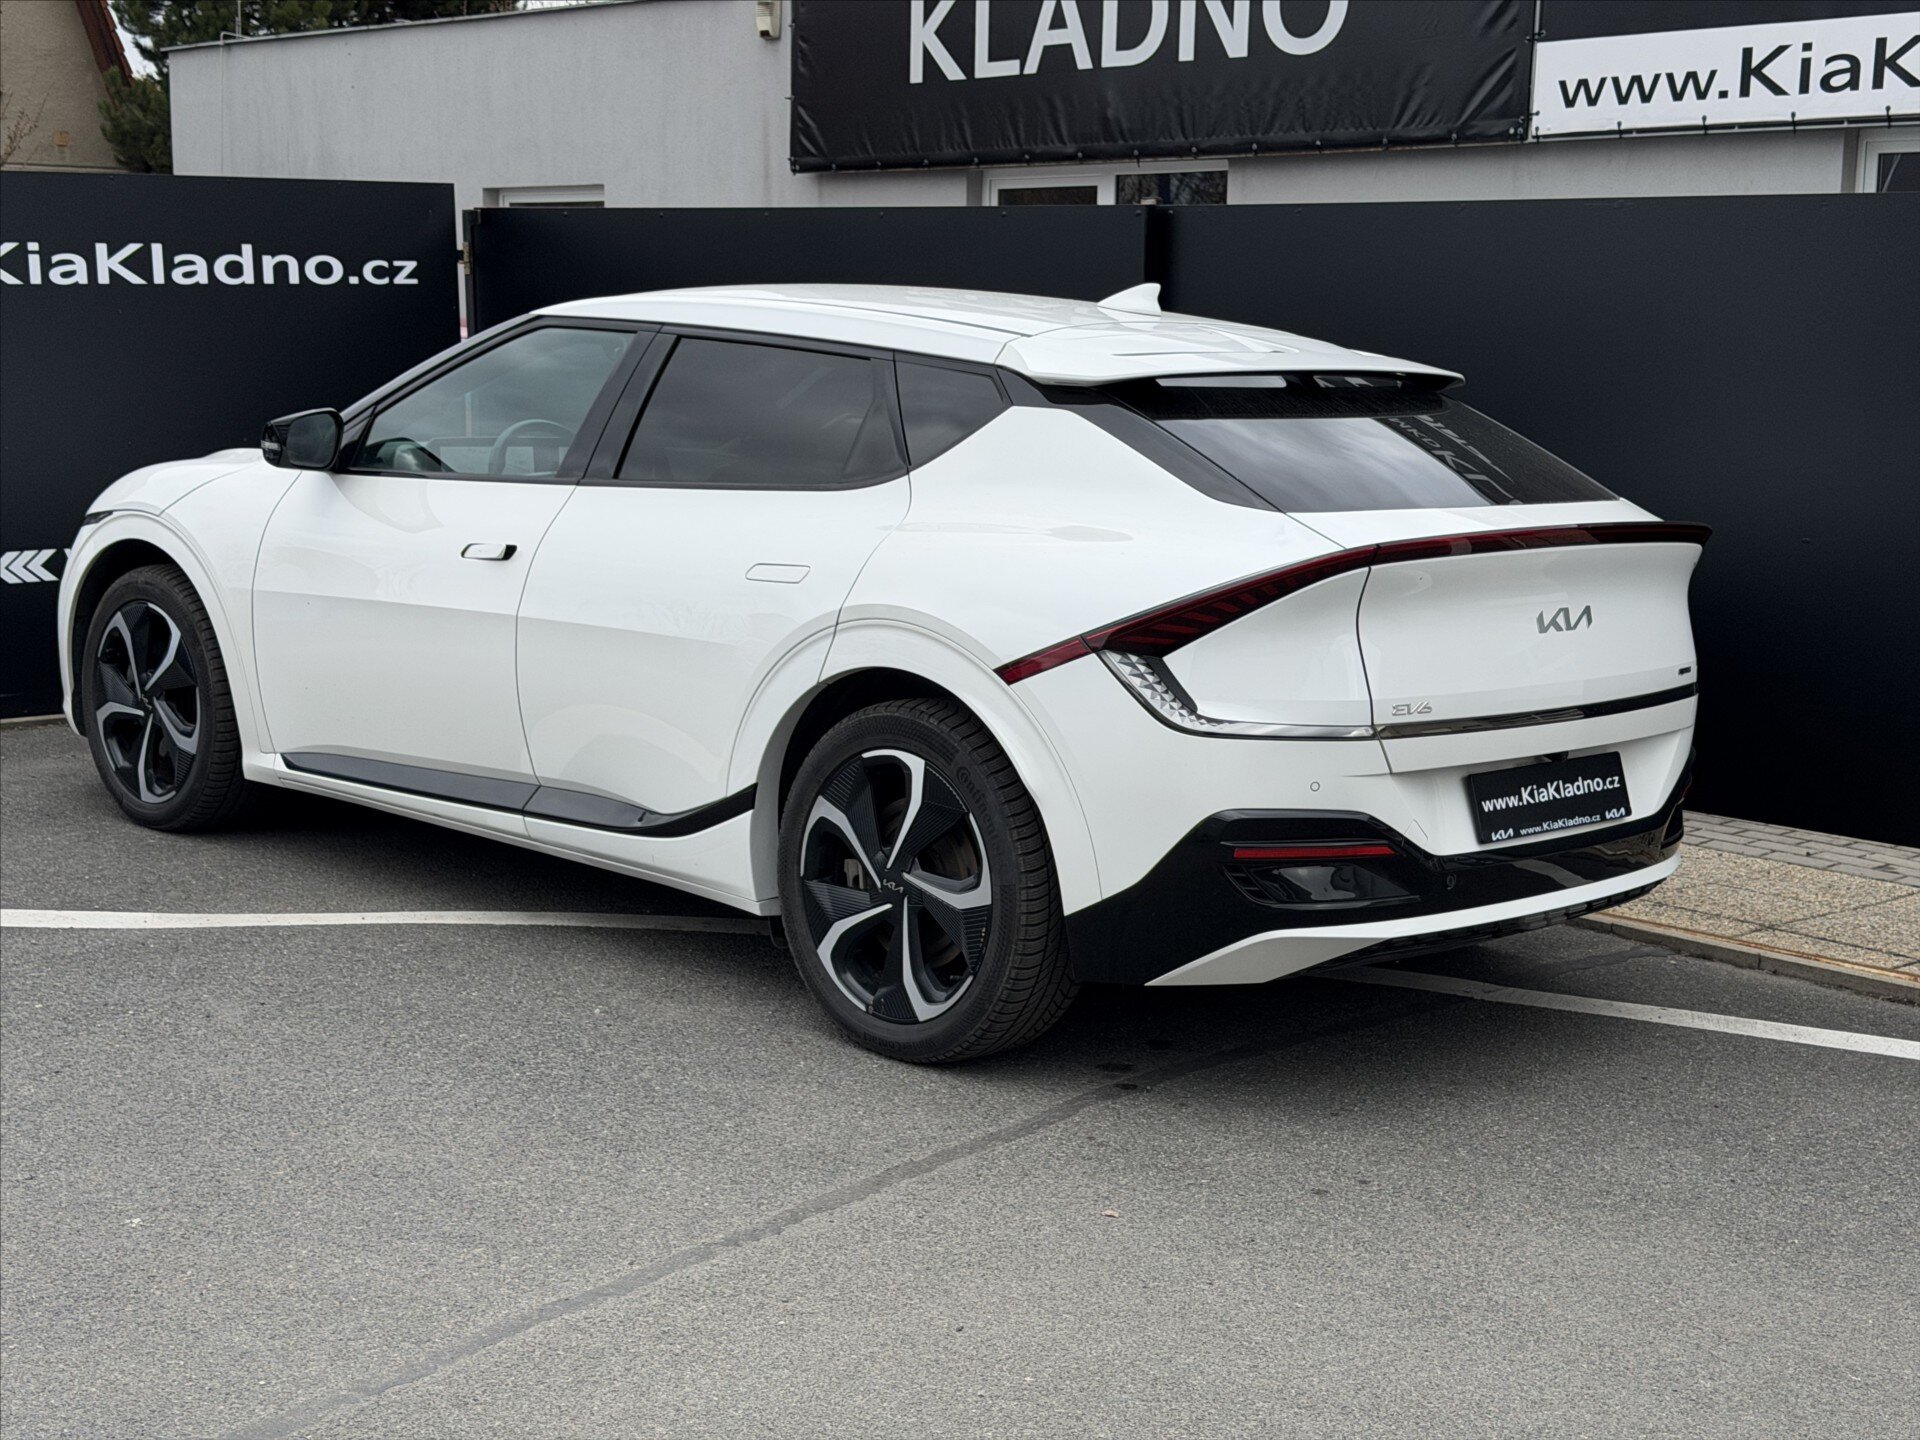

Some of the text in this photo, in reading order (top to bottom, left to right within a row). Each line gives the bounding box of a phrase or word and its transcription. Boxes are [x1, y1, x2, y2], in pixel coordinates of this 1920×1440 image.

[909, 0, 1349, 84] KLADNO
[1558, 34, 1920, 109] www.KiaK
[1536, 604, 1593, 634] KIA
[1391, 698, 1433, 716] EV6
[1481, 775, 1621, 813] www.KiaKladno.cz
[1519, 813, 1602, 836] www.KiaKladno.cz
